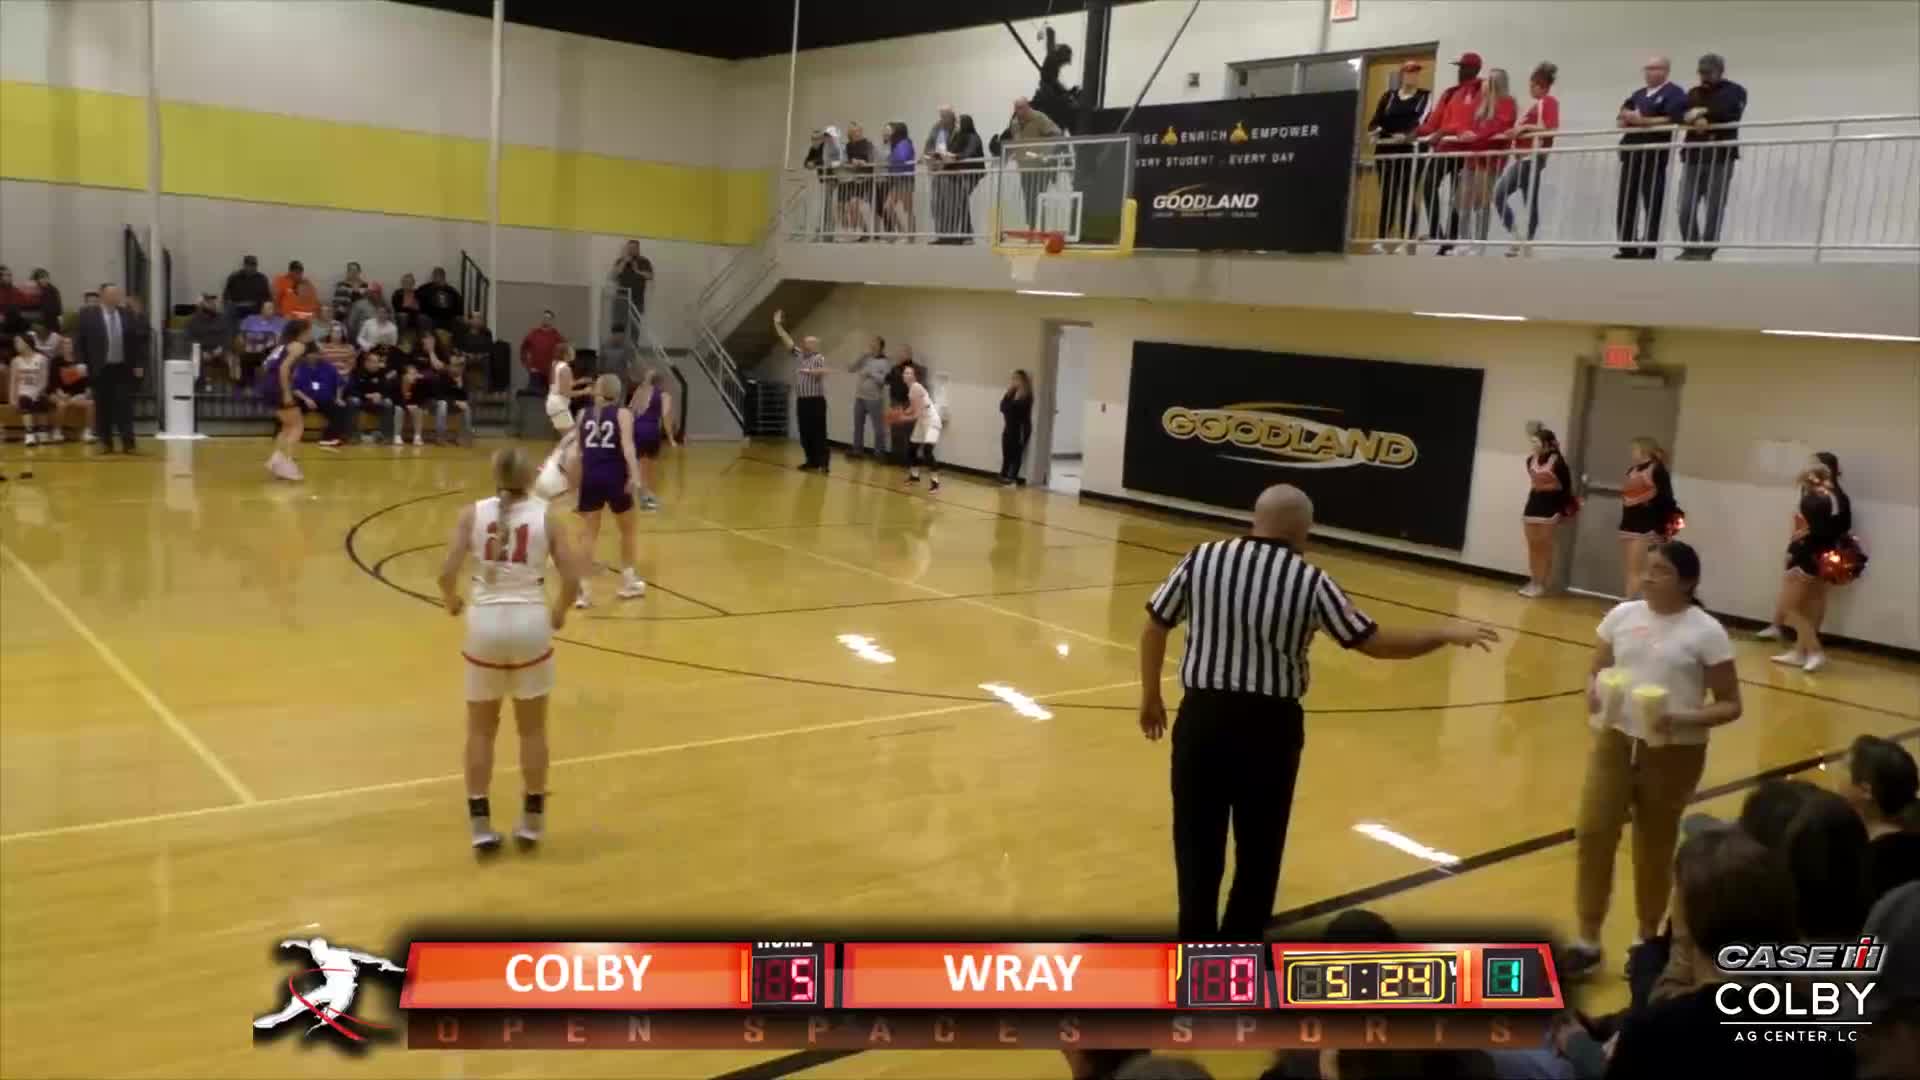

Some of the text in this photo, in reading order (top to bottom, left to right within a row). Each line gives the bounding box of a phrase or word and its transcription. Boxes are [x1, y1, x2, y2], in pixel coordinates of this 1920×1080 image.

[1181, 129, 1227, 143] ENRICH
[1251, 125, 1319, 140] EMPOWER
[1166, 155, 1215, 168] STUDENT
[1229, 154, 1267, 165] EVERY
[1272, 152, 1295, 163] DAY
[1153, 194, 1259, 209] GOODLAND
[585, 420, 615, 448] 22
[1162, 406, 1418, 469] GOODLAND
